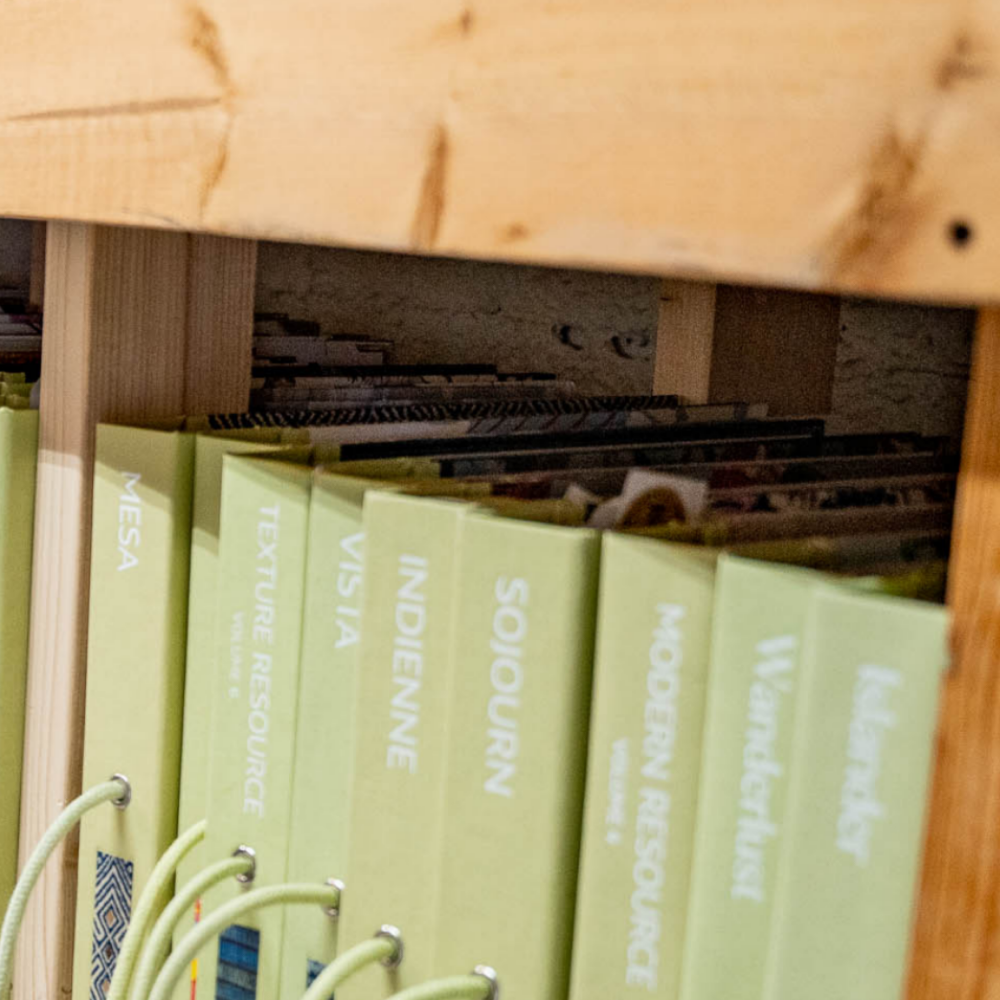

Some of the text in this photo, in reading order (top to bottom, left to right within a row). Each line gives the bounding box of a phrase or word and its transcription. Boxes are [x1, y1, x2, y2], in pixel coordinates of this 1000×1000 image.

[116, 471, 142, 572] MESA
[243, 504, 281, 819] TEXTURE RESOURCE
[386, 553, 429, 775] INDIENNE
[483, 575, 530, 799] SOJOURN
[729, 633, 798, 906] Wanderlust
[835, 662, 904, 868] Islander
[625, 602, 687, 993] MODERN RESOURCE
